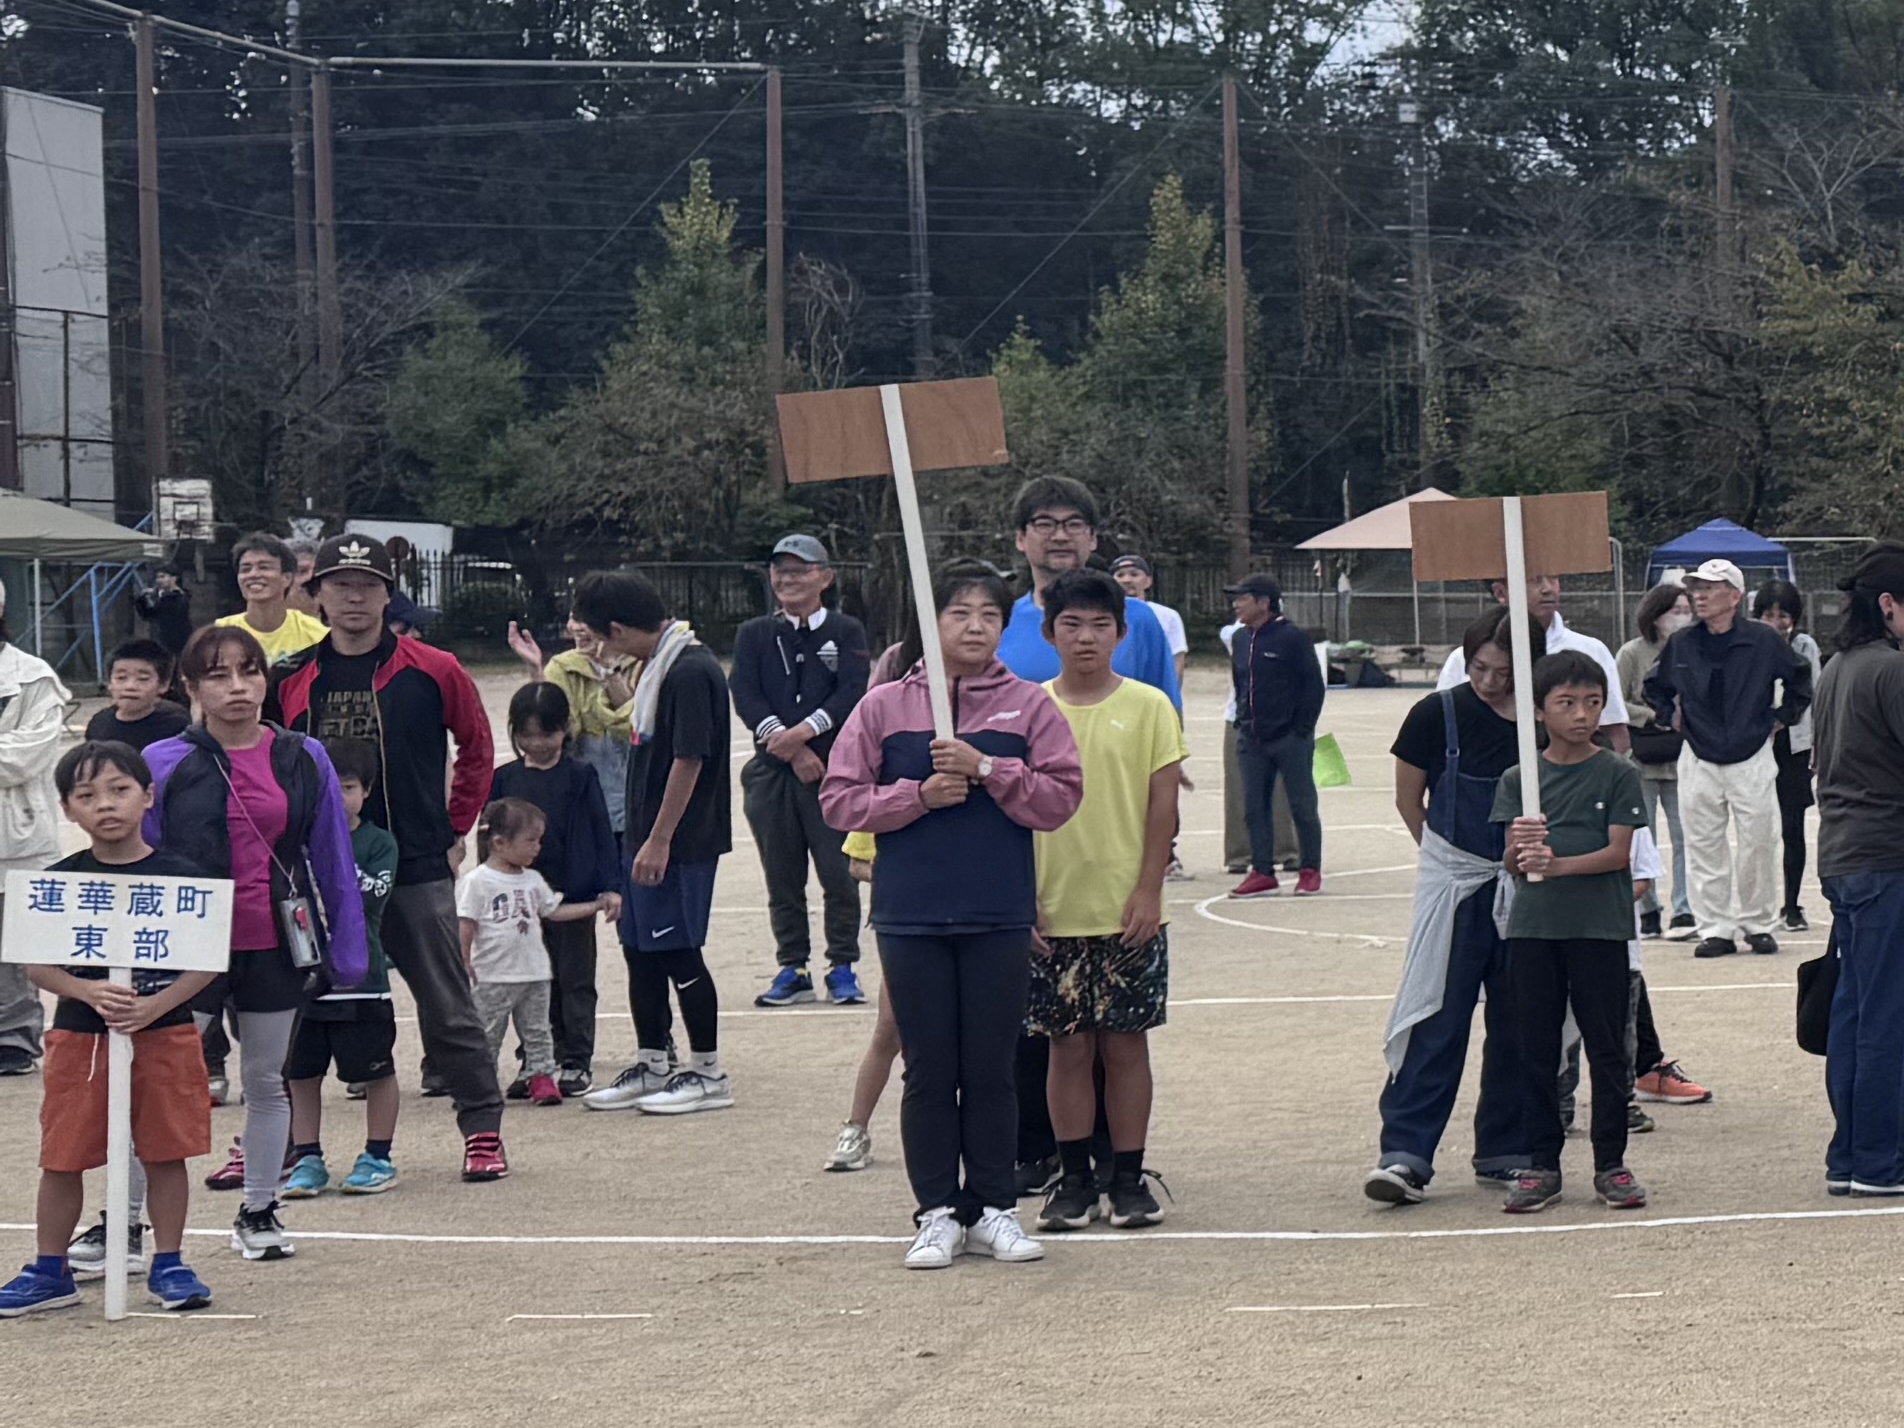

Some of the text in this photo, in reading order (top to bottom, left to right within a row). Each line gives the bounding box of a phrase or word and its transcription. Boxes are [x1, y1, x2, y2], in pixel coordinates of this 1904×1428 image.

[28, 878, 214, 919] 蓮華蔵町
[70, 924, 170, 963] 東部
